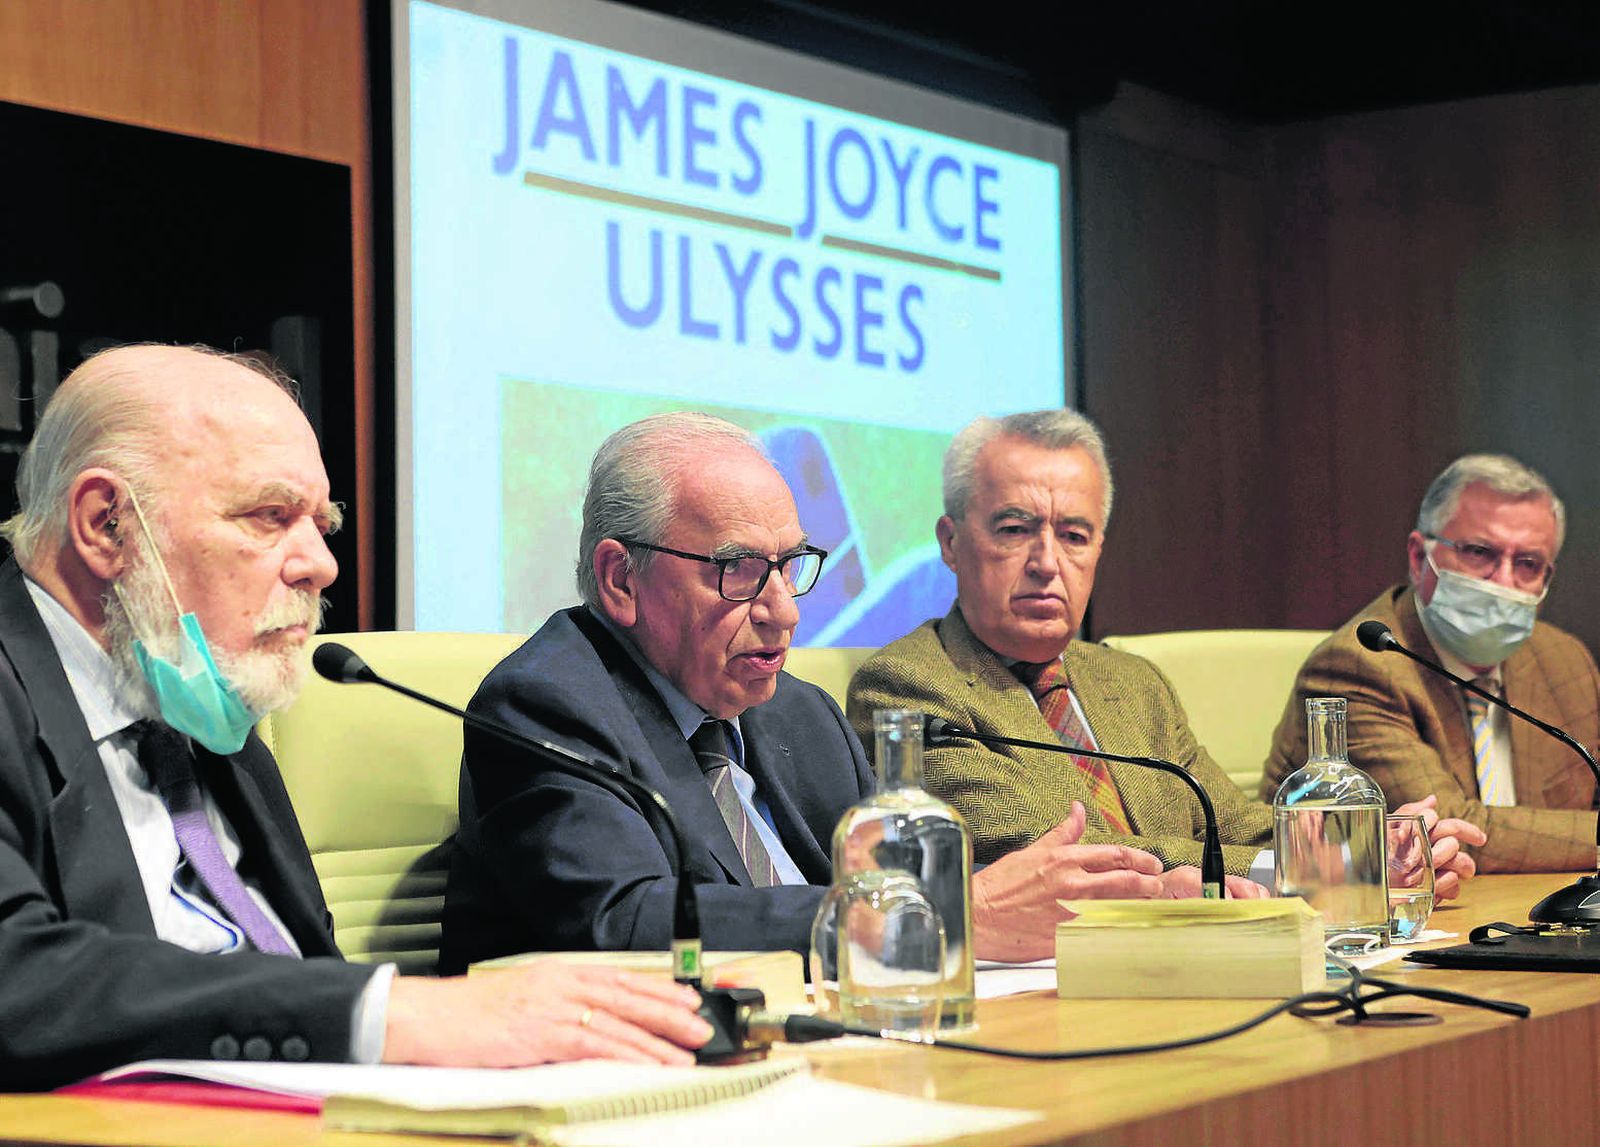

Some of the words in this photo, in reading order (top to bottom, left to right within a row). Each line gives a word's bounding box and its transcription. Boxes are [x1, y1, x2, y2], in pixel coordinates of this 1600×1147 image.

[493, 36, 763, 196] JAMES
[794, 118, 1002, 252] JOYCE
[606, 219, 926, 374] ULYSSES
